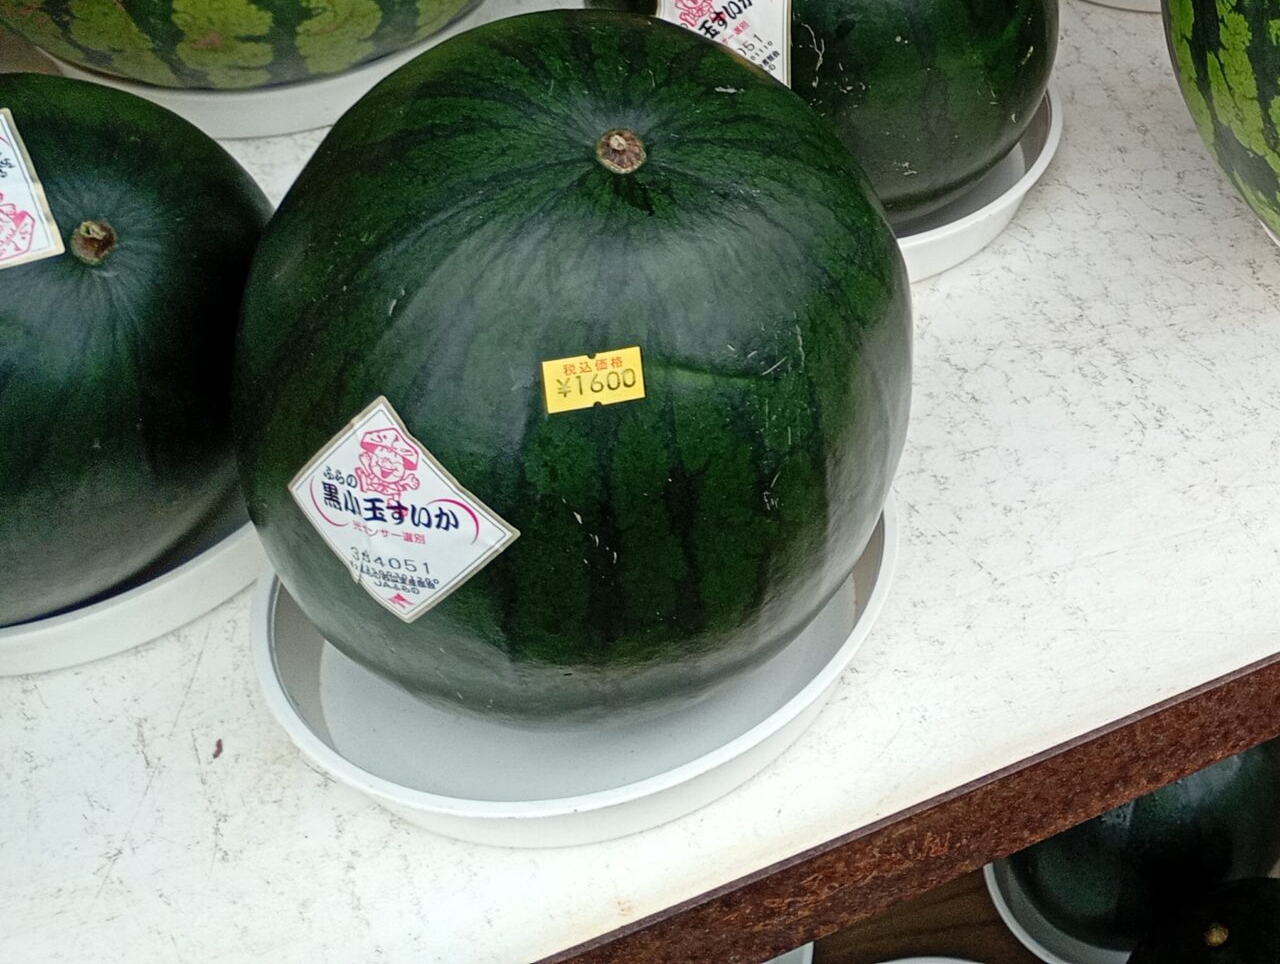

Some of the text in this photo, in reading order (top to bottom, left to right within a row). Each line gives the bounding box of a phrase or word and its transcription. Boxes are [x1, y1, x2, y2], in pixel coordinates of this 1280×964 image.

[562, 355, 625, 377] 税込価格
[556, 368, 637, 398] ¥1600
[320, 480, 460, 532] 黒小玉すいか
